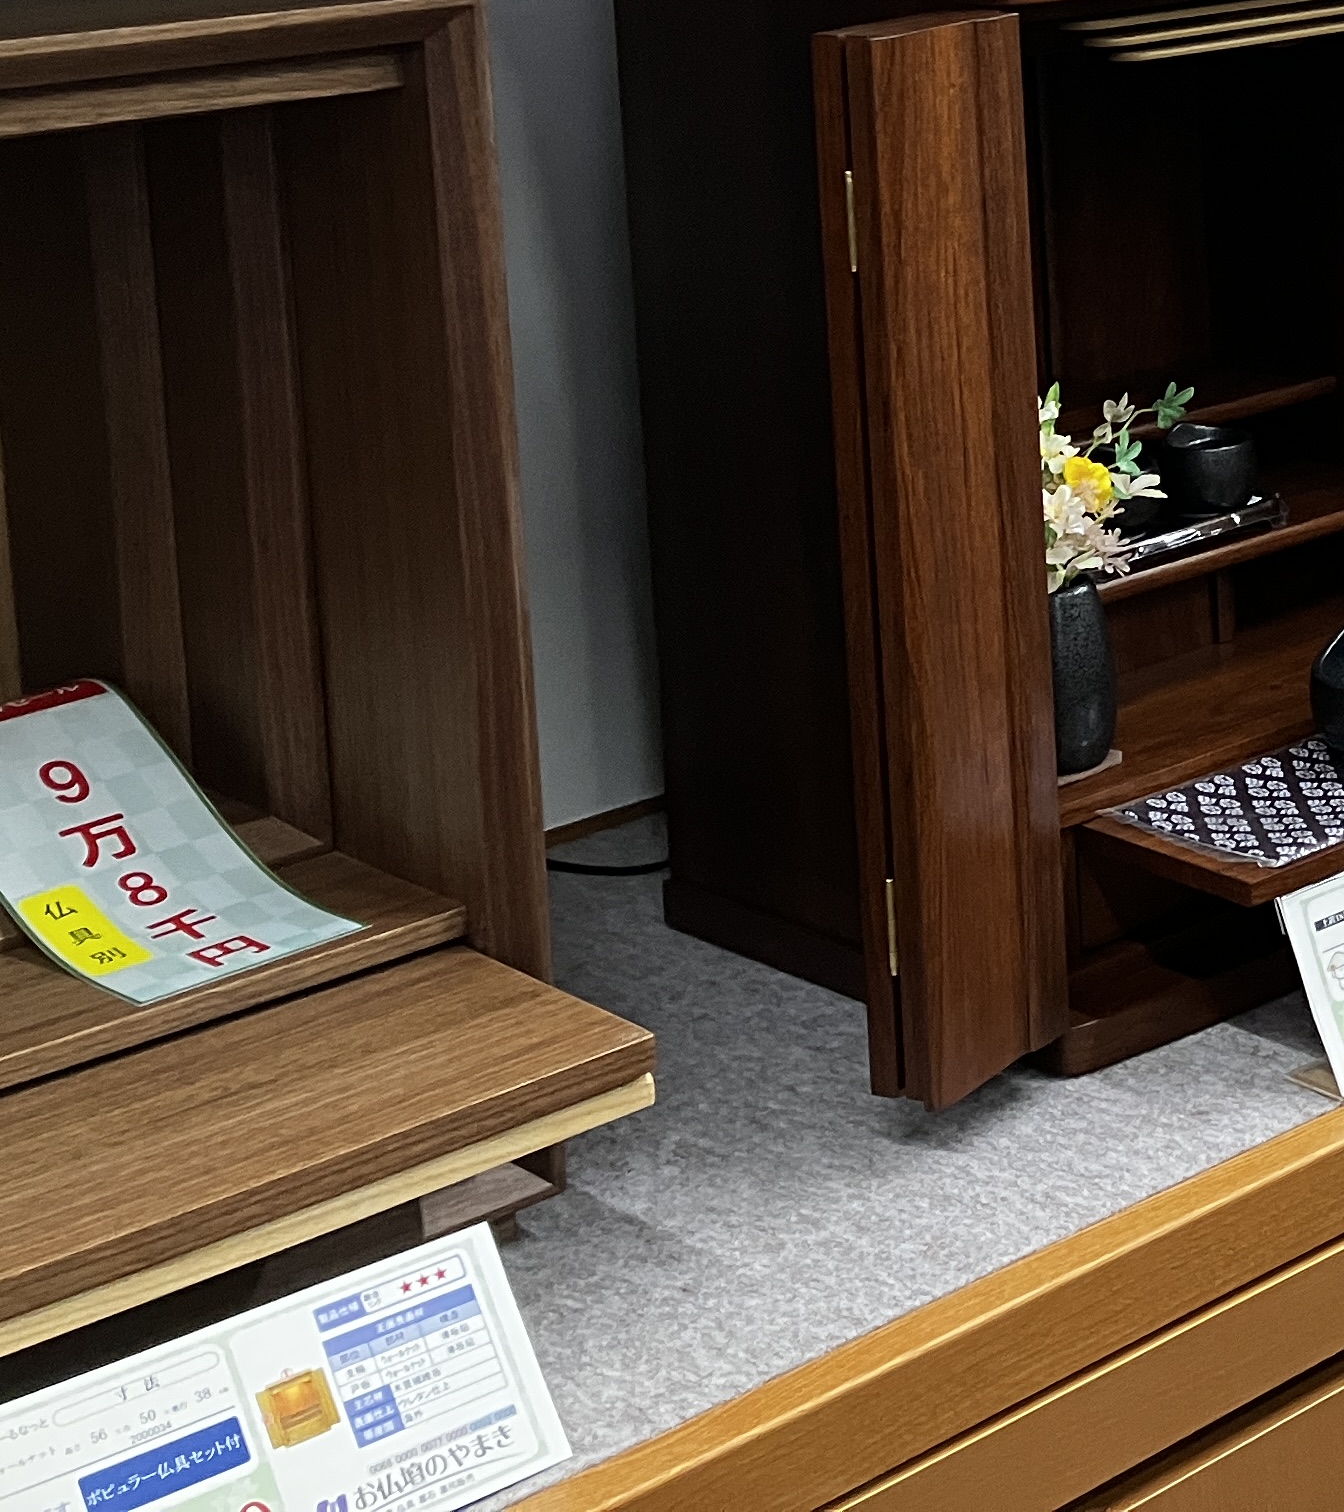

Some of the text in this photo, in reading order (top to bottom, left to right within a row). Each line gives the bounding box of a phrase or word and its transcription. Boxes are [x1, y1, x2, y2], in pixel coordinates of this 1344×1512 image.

[38, 760, 273, 968] 9万8千円
[43, 900, 129, 967] 仏具別
[139, 1409, 157, 1425] 50
[193, 1387, 212, 1404] 38
[86, 1432, 242, 1507] ポピュラー仏具セット付
[352, 1423, 516, 1511] お仏壇のやまき
